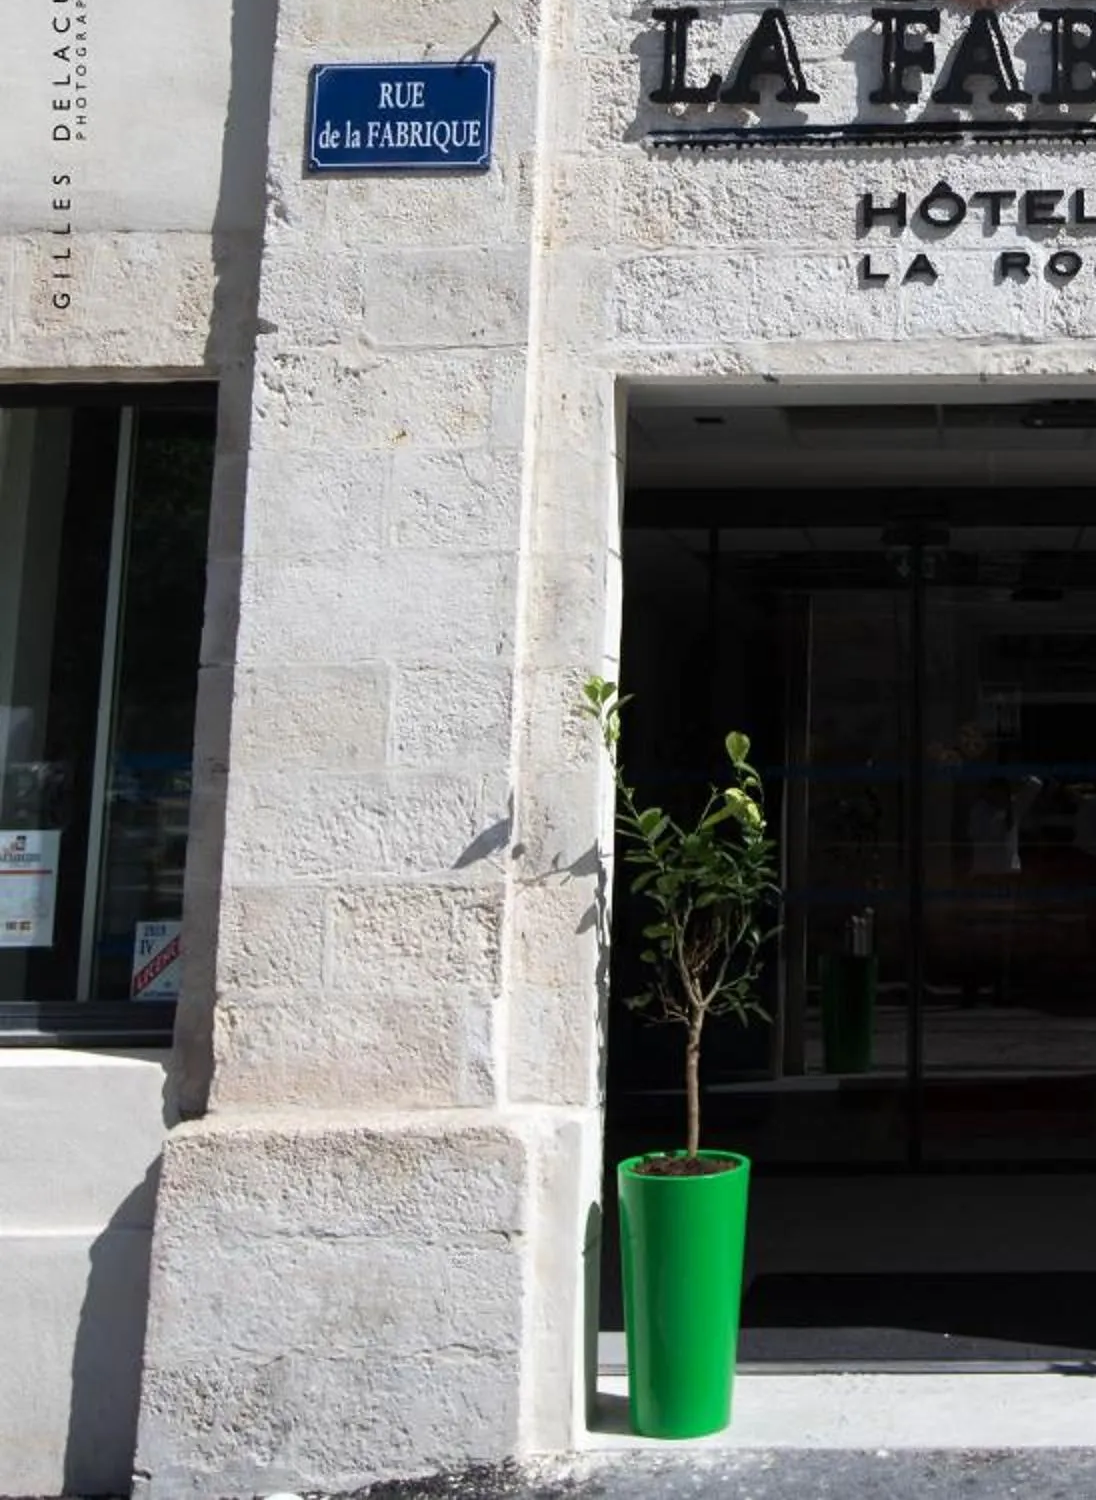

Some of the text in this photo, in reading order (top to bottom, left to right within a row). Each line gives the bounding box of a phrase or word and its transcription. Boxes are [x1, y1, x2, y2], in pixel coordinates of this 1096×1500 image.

[649, 8, 820, 104] LA
[378, 81, 426, 109] RUE
[319, 120, 481, 153] de la FABRIQUE
[863, 253, 939, 281] LA
